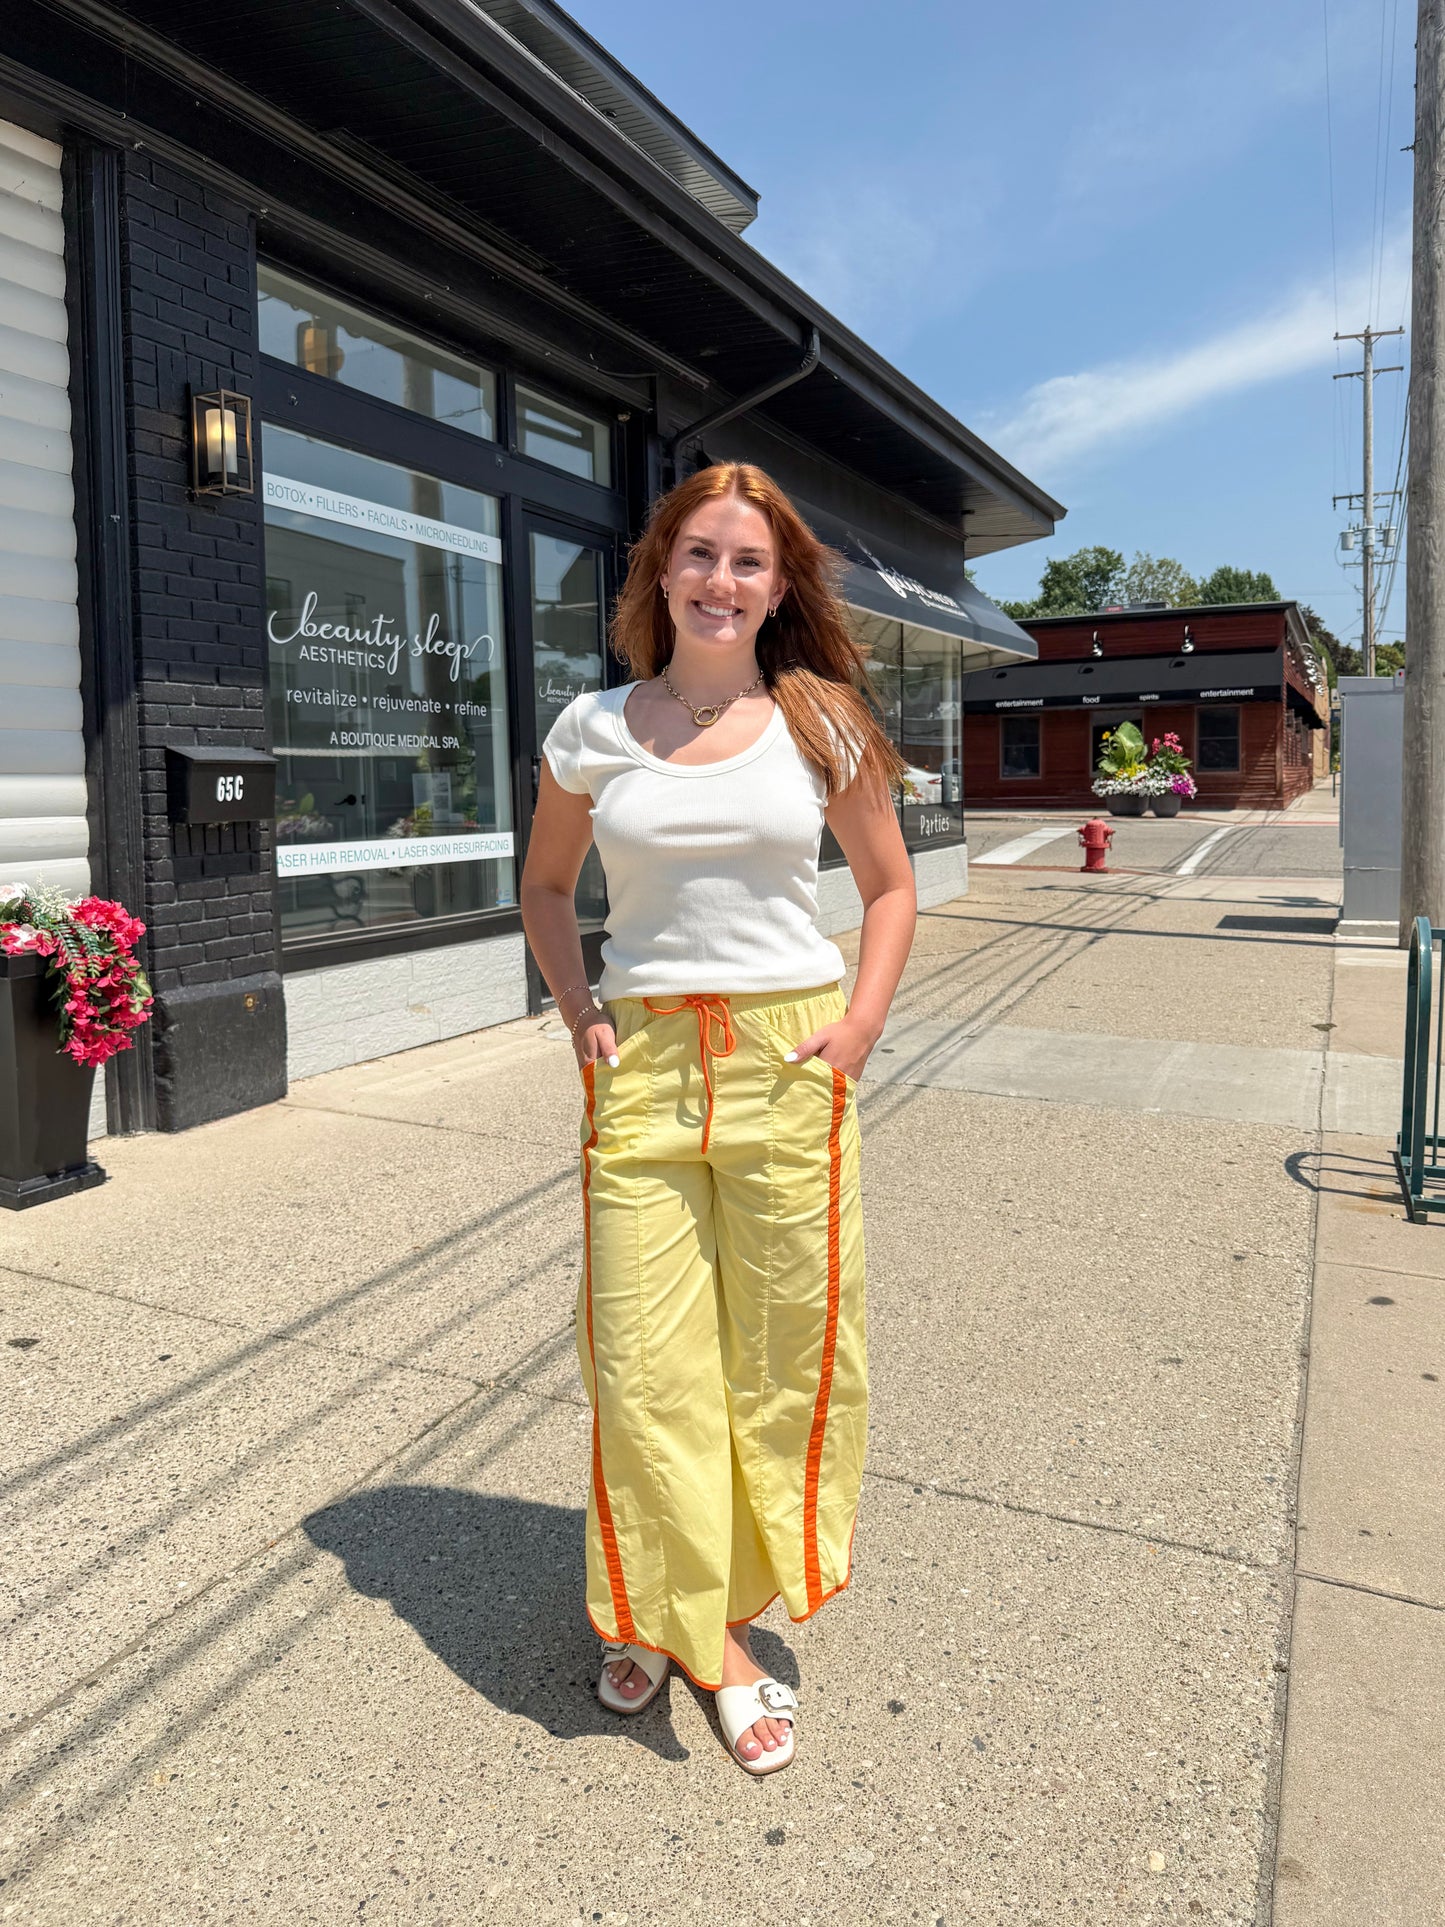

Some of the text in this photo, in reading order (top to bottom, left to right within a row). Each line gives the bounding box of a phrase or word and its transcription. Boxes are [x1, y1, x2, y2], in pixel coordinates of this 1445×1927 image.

[267, 482, 489, 554] BOTOX FILLERS FACIALS MICRONEEDLING
[267, 591, 495, 683] beauty sleep
[299, 645, 386, 669] AESTHETICS
[286, 687, 487, 717] revitalize rejuvenate refine
[539, 679, 576, 701] beauty
[1082, 696, 1101, 704] food
[1199, 688, 1255, 698] entertainment
[995, 699, 1044, 708] entertainment
[329, 731, 460, 750] A BOUTIQUE MEDICAL SPA
[216, 775, 244, 802] 65C
[920, 813, 950, 837] Parties
[310, 850, 337, 866] HAIR
[340, 847, 390, 864] REMOVAL
[398, 844, 429, 860] LASER
[430, 841, 451, 857] SKIN
[453, 839, 510, 855] RESURFACING
